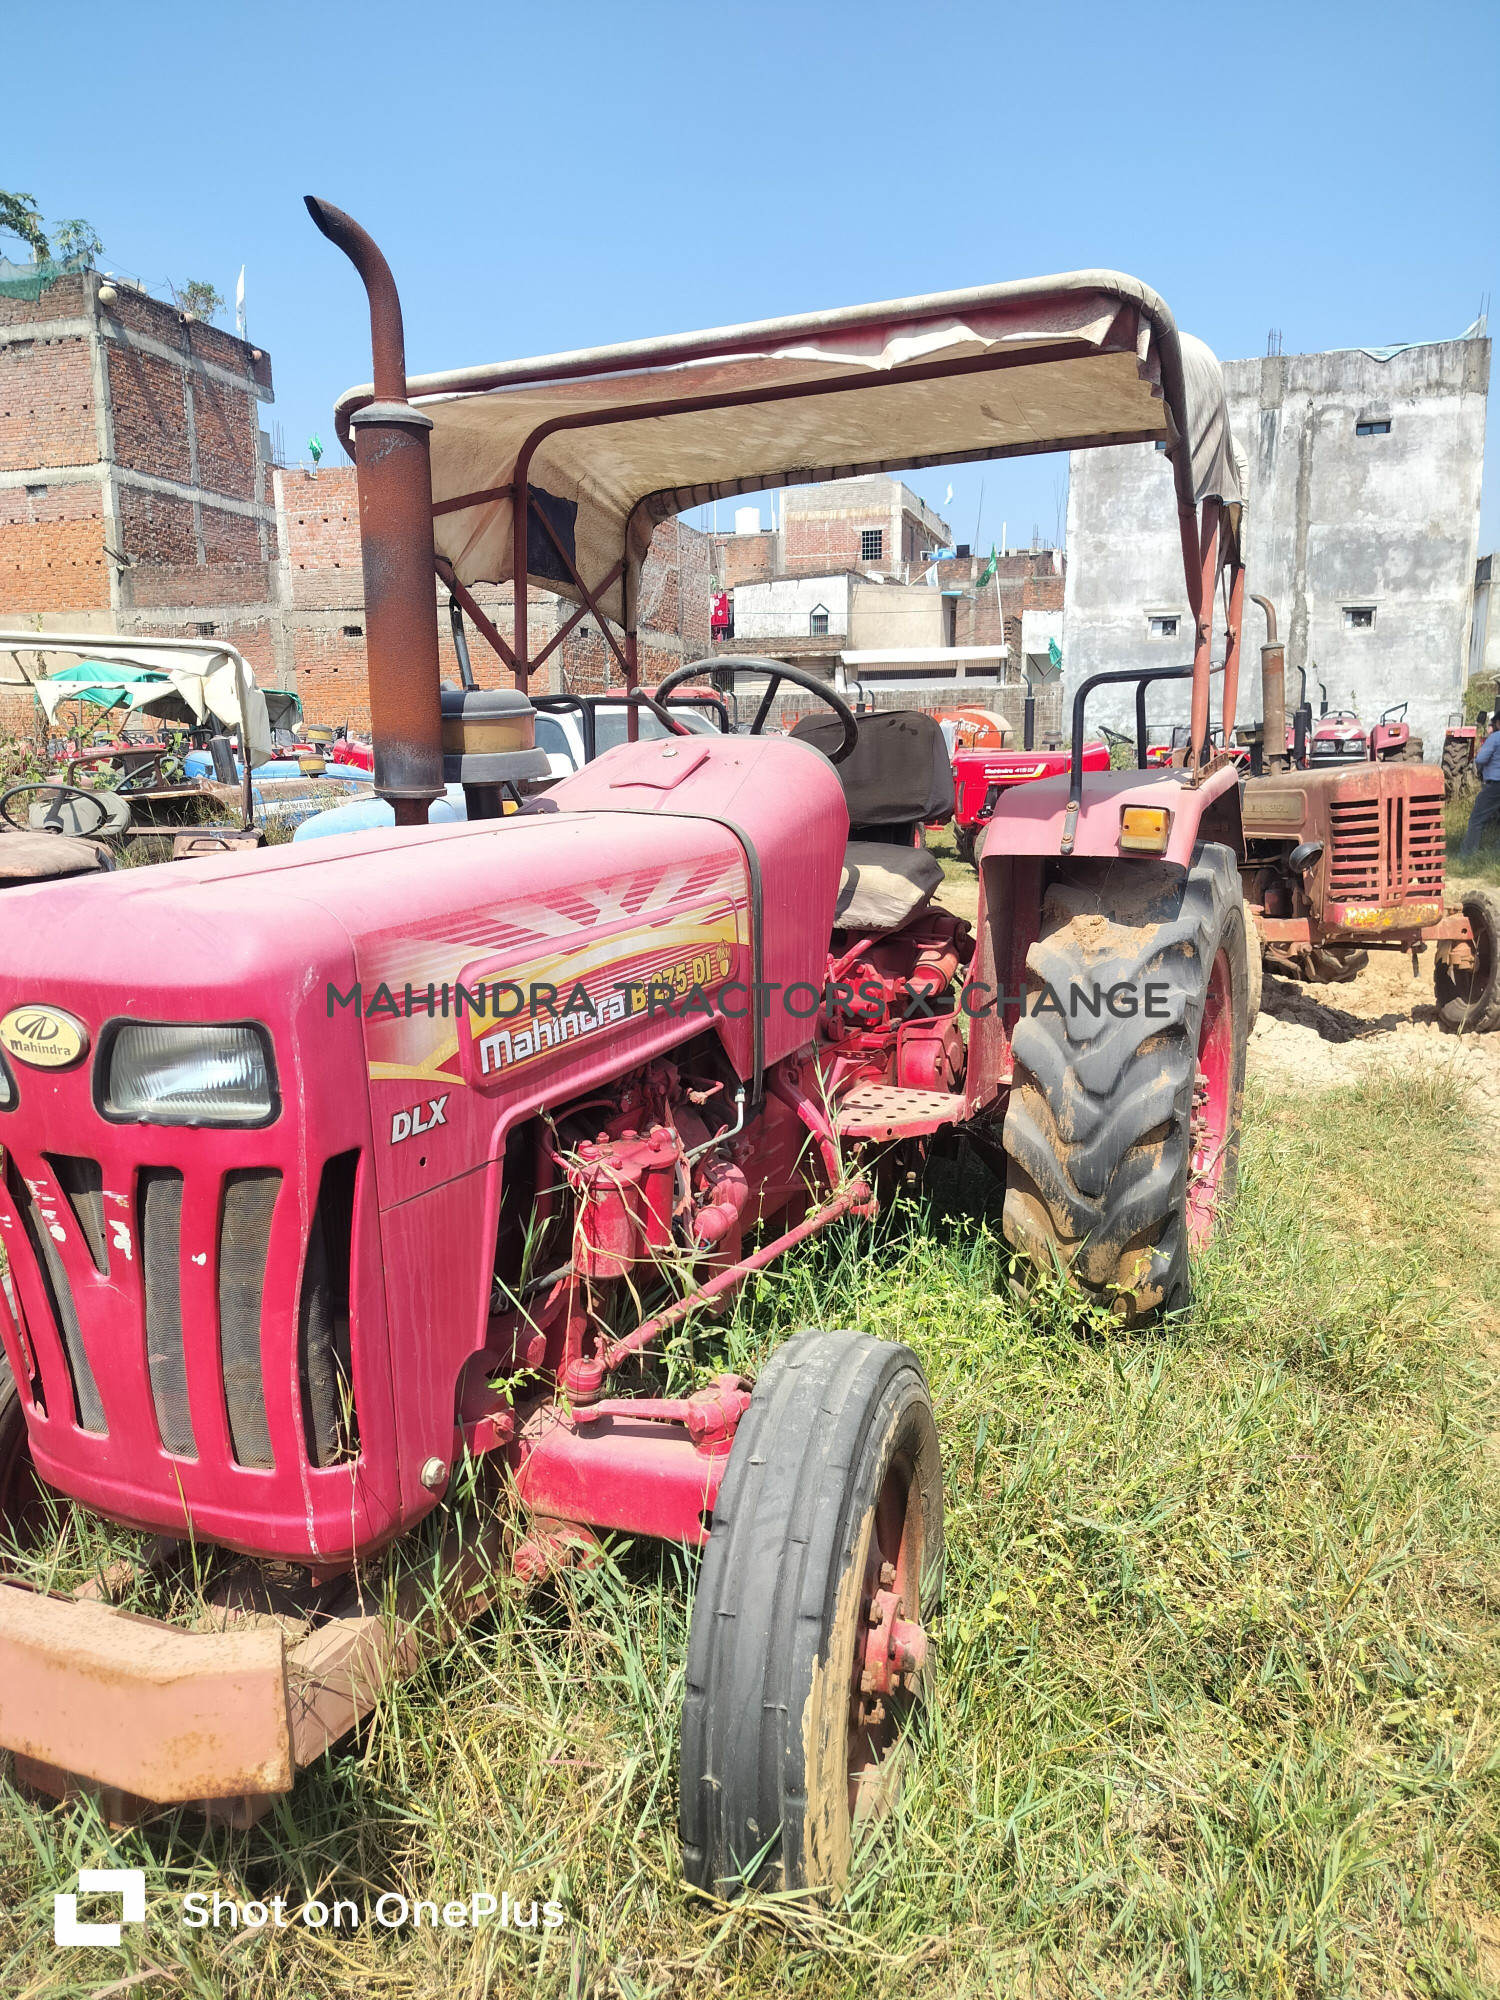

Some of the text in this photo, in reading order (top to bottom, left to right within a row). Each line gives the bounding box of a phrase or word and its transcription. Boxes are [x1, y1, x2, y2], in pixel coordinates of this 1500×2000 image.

[479, 952, 712, 1075] Mahindra B 275 DI
[10, 1039, 71, 1056] Mahindra
[391, 1094, 449, 1145] DLX
